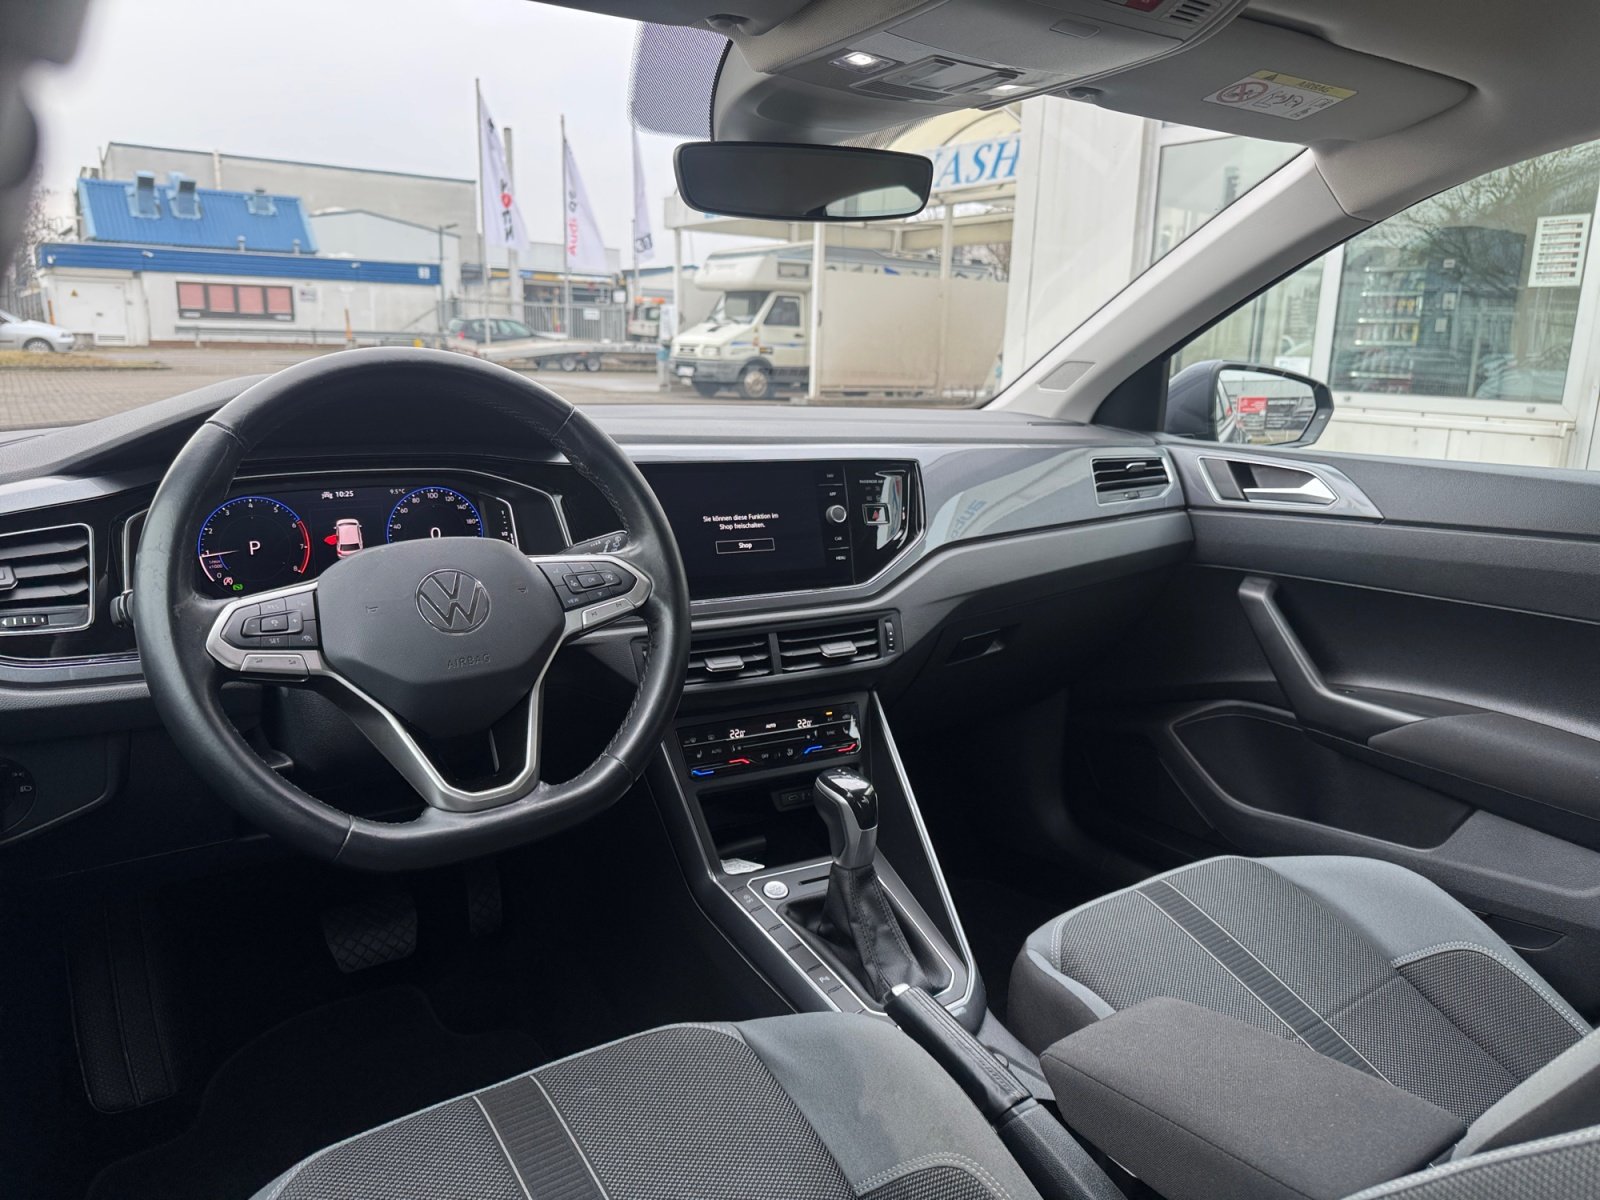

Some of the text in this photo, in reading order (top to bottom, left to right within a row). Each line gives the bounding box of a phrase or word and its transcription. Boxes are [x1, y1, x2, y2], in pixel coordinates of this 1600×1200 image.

[567, 217, 579, 257] Audi
[335, 490, 354, 498] 10:25
[712, 514, 732, 522] können
[719, 523, 733, 531] Shop
[249, 540, 261, 556] P
[738, 542, 753, 550] Shop
[447, 653, 491, 670] AIRBAG
